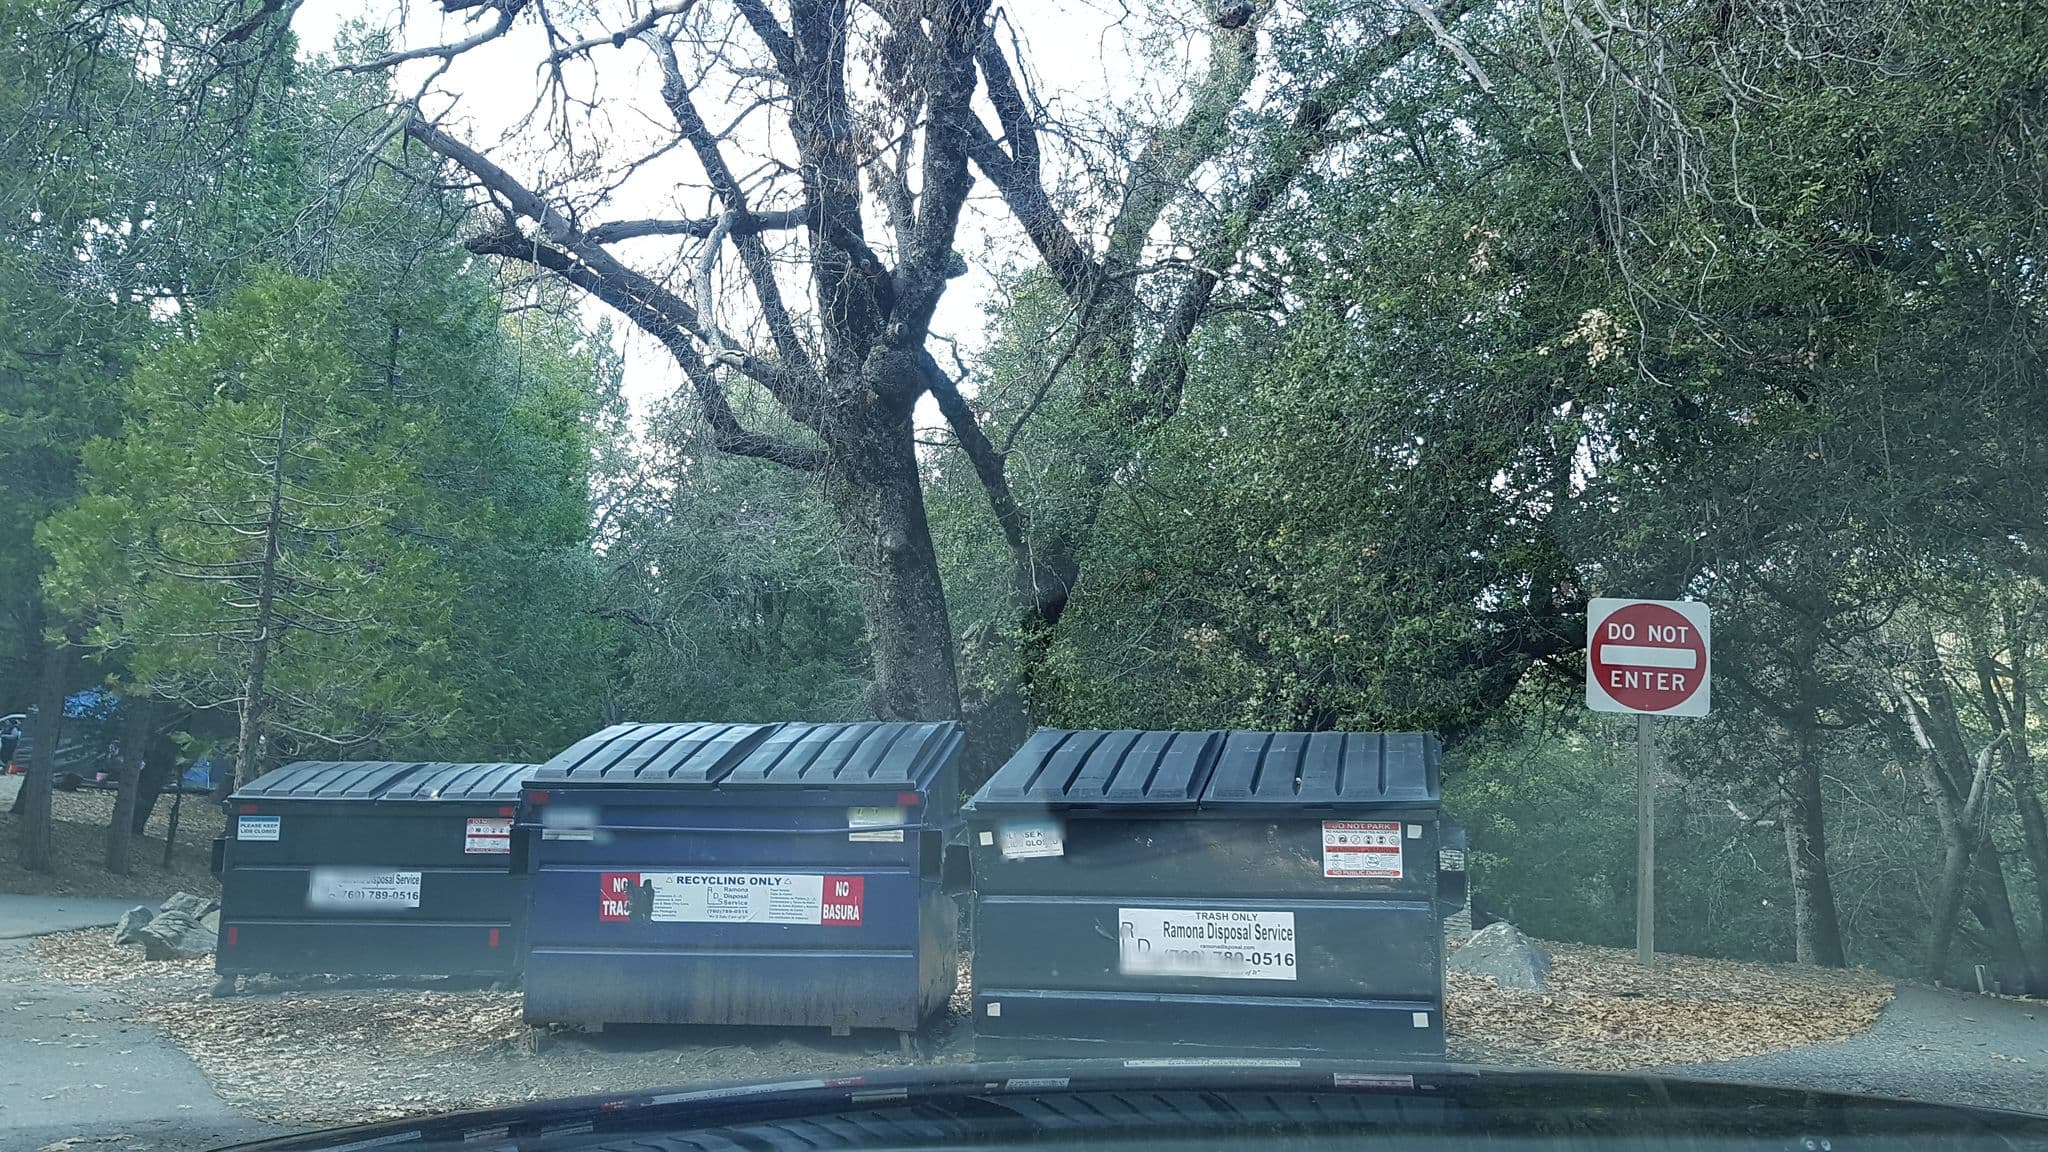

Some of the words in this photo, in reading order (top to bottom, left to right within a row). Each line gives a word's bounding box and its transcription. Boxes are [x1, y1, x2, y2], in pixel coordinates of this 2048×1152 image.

[1607, 622, 1635, 640] DO
[1648, 625, 1689, 643] NOT
[1611, 670, 1685, 692] ENTER
[396, 874, 419, 885] Service
[677, 876, 745, 885] RECYCLING
[749, 877, 782, 886] ONLY
[369, 890, 419, 900] 789-0516
[836, 881, 849, 896] NO
[603, 900, 632, 916] TRA
[823, 904, 860, 920] BASURA
[1195, 912, 1229, 921] TRASH
[1231, 912, 1258, 922] ONLY
[1163, 921, 1204, 939] Ramona
[1207, 922, 1252, 944] Disposal
[1254, 923, 1293, 941] Service
